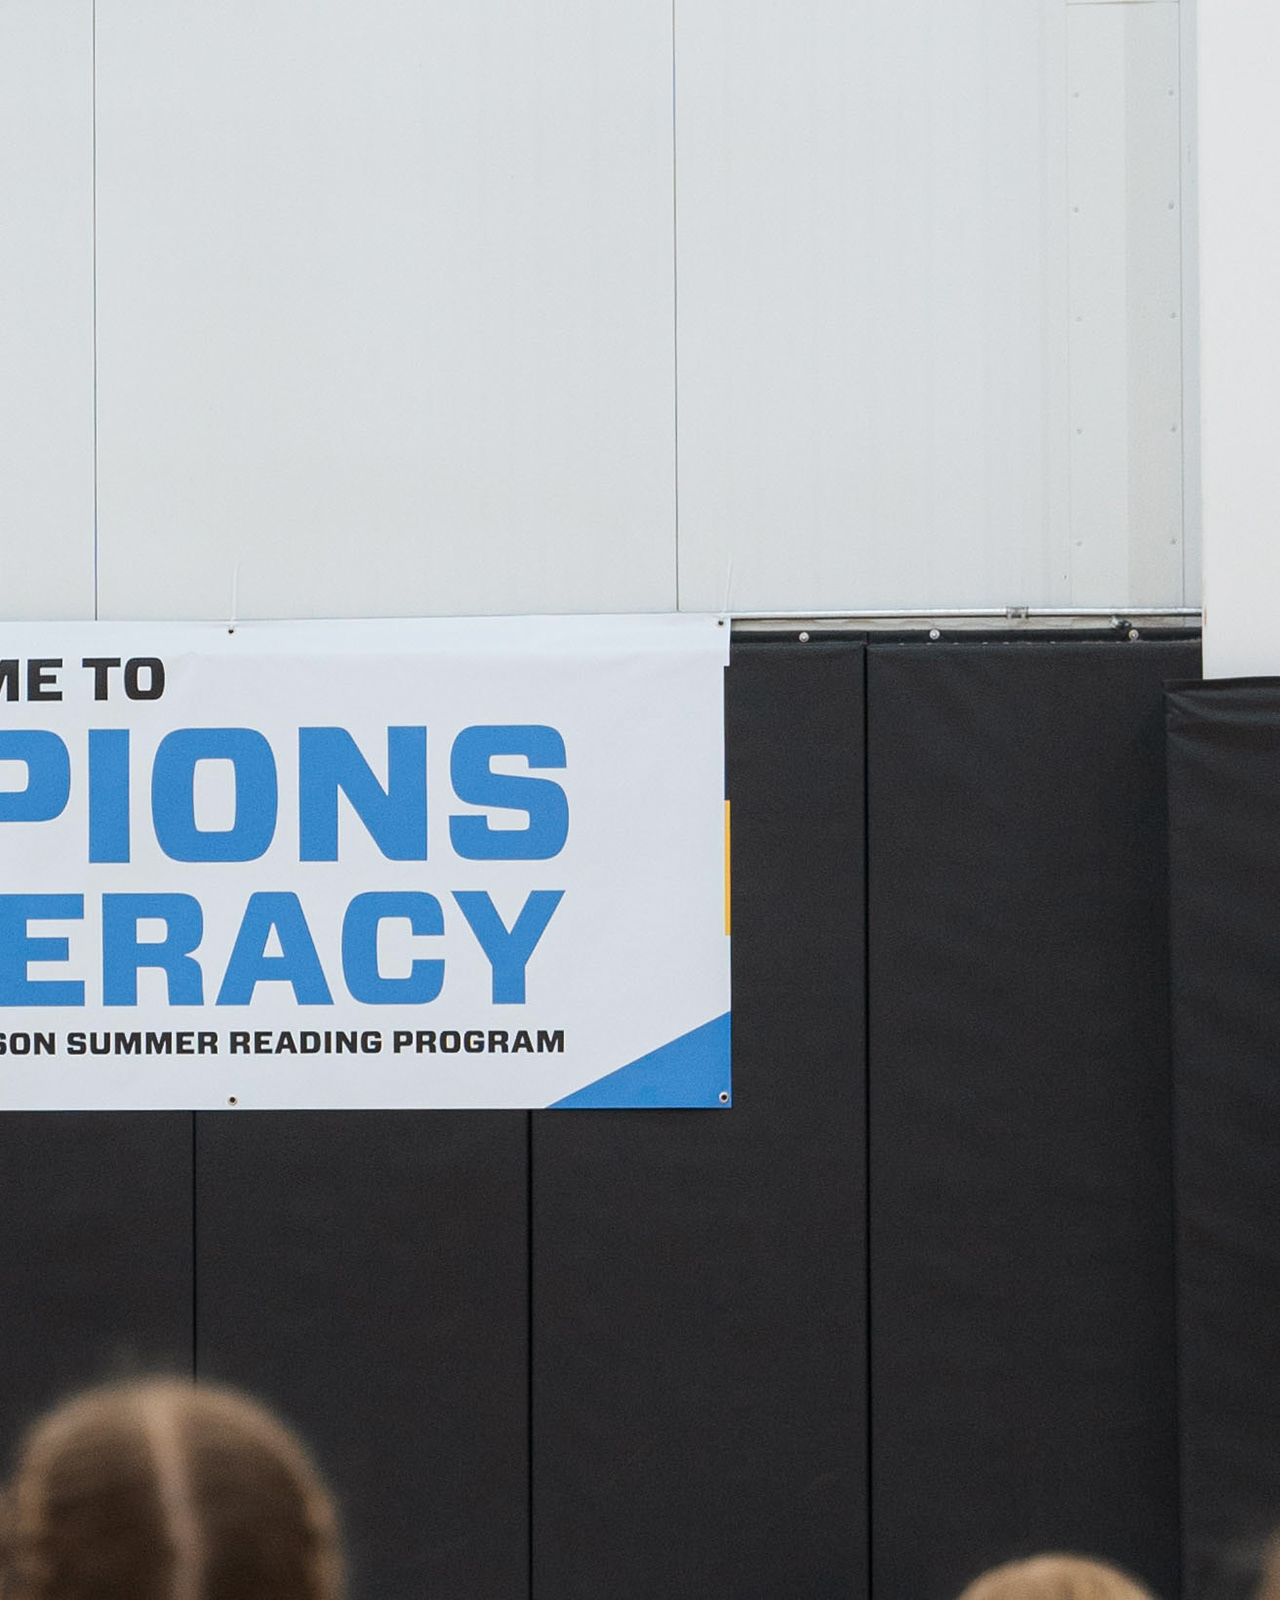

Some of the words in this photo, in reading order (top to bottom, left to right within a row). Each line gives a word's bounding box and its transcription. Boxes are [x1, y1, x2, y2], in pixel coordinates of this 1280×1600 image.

[83, 657, 165, 701] TO
[66, 1031, 218, 1055] SUMMER
[229, 1031, 382, 1054] READING
[393, 1030, 565, 1054] PROGRAM
